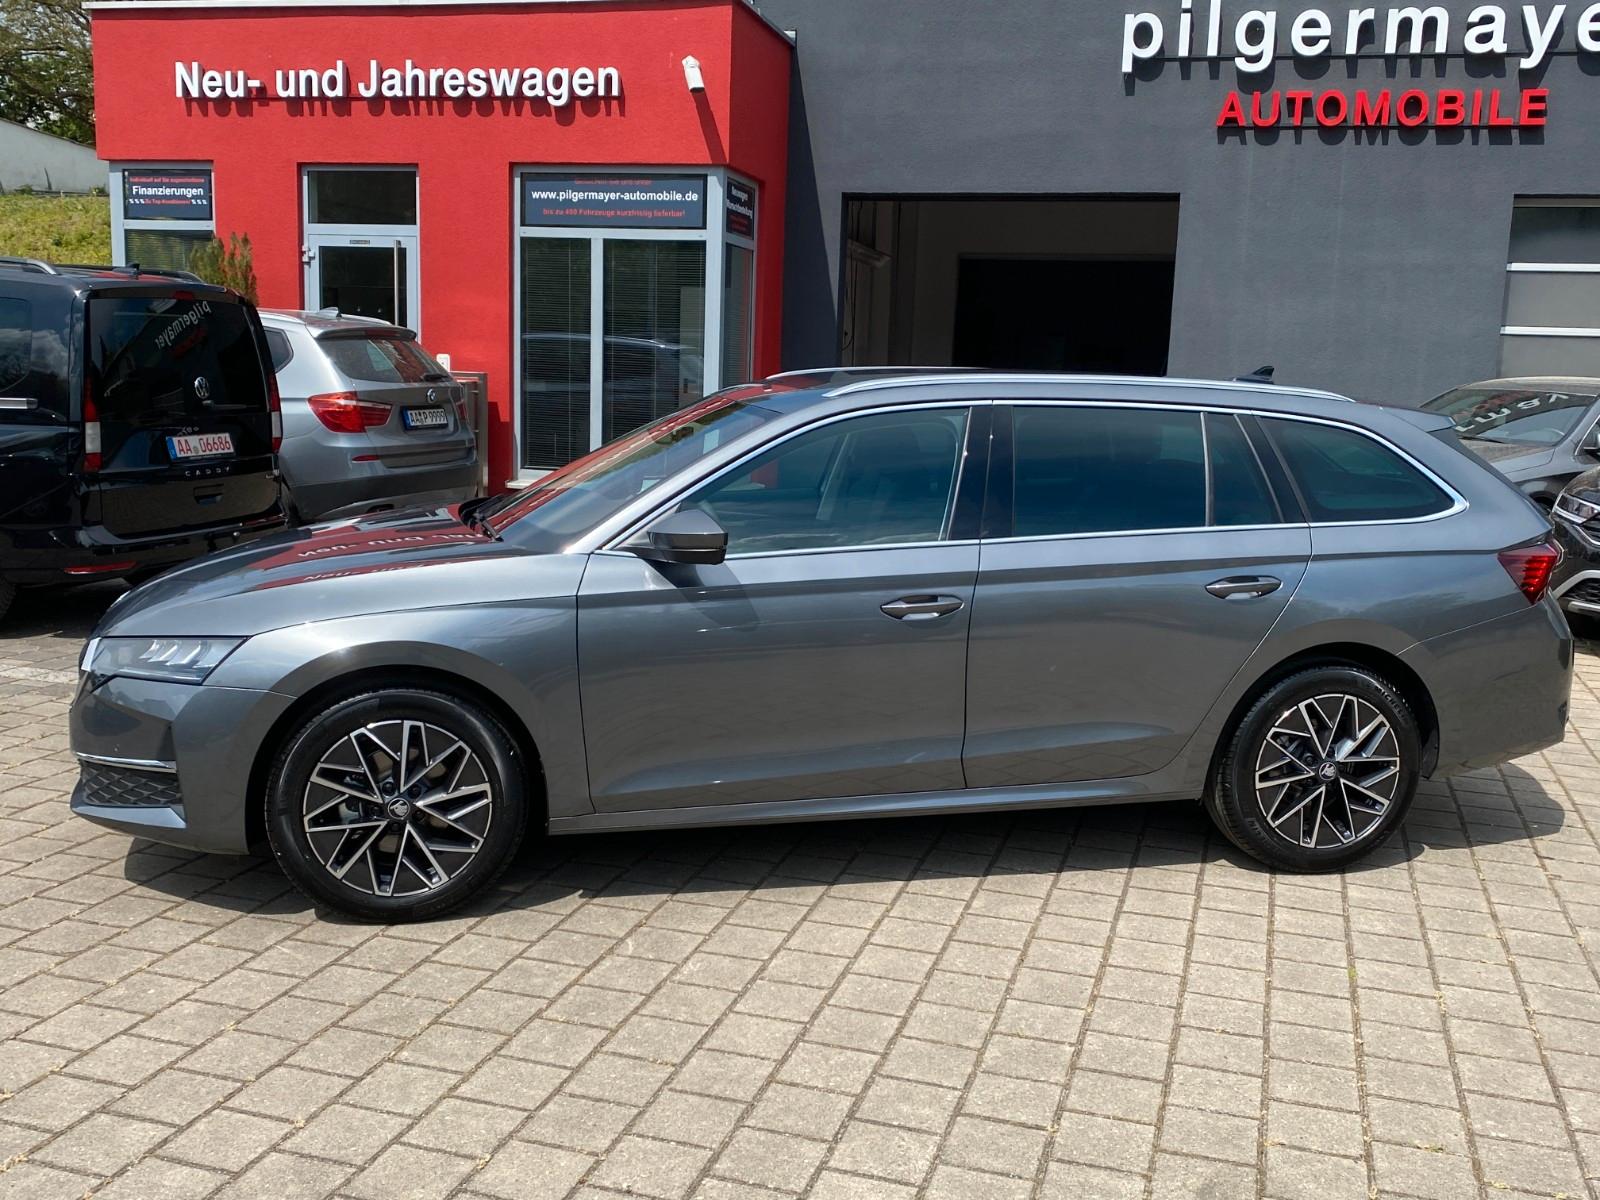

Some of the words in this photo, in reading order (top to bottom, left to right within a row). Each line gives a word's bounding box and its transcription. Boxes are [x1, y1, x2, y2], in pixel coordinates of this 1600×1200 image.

[174, 61, 261, 98] Neu-
[275, 61, 344, 98] und
[358, 60, 620, 106] Jahreswagen
[1216, 89, 1549, 127] AUTOMOBILE
[132, 186, 204, 198] Finanzierungen
[531, 189, 699, 202] www.pilgermayer-automobile.de
[178, 439, 193, 455] AA
